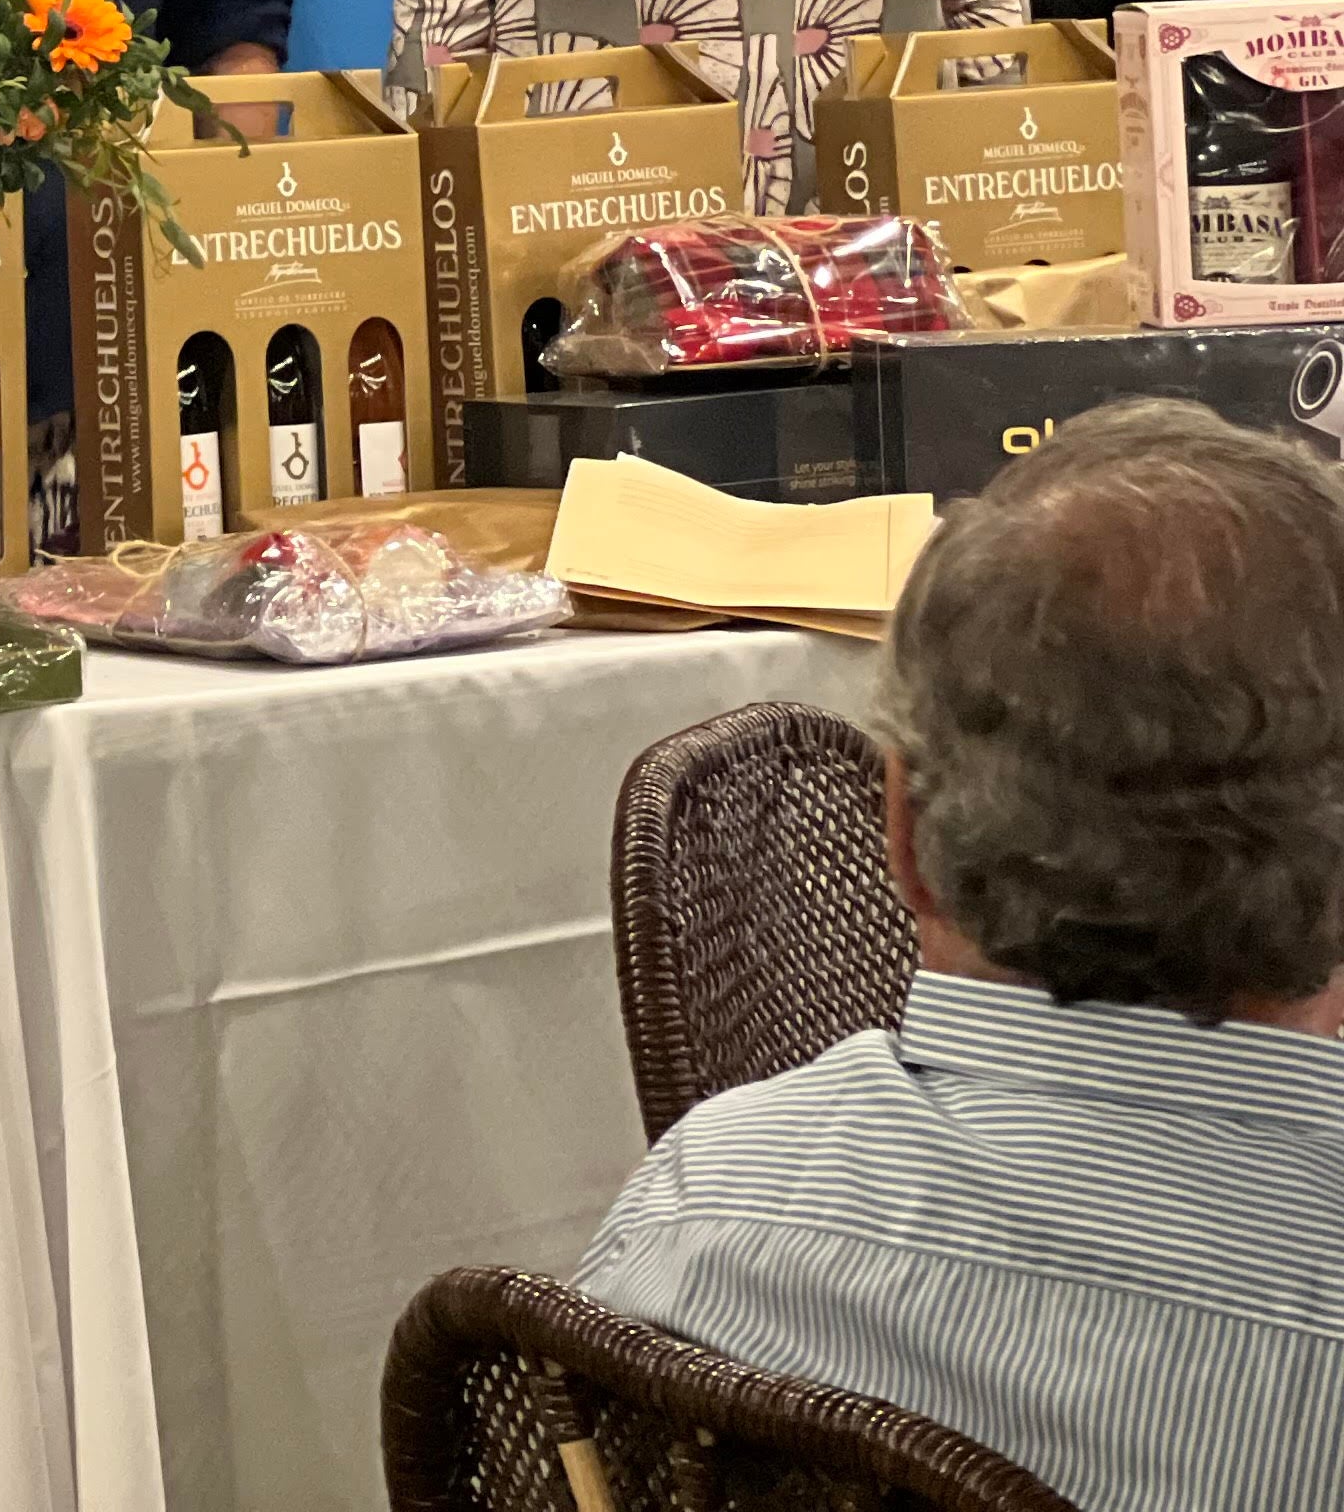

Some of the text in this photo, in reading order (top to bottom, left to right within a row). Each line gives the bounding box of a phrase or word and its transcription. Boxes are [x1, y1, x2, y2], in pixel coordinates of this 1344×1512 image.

[1244, 30, 1344, 59] MOMBA
[570, 165, 673, 186] MIGUEL DOMECQ
[235, 197, 345, 216] MIGUEL DOMECQ
[510, 186, 727, 235] ENTRECHUELOS
[428, 169, 467, 484] NTRECHUELOS
[121, 256, 144, 494] www.migueldomecq.com
